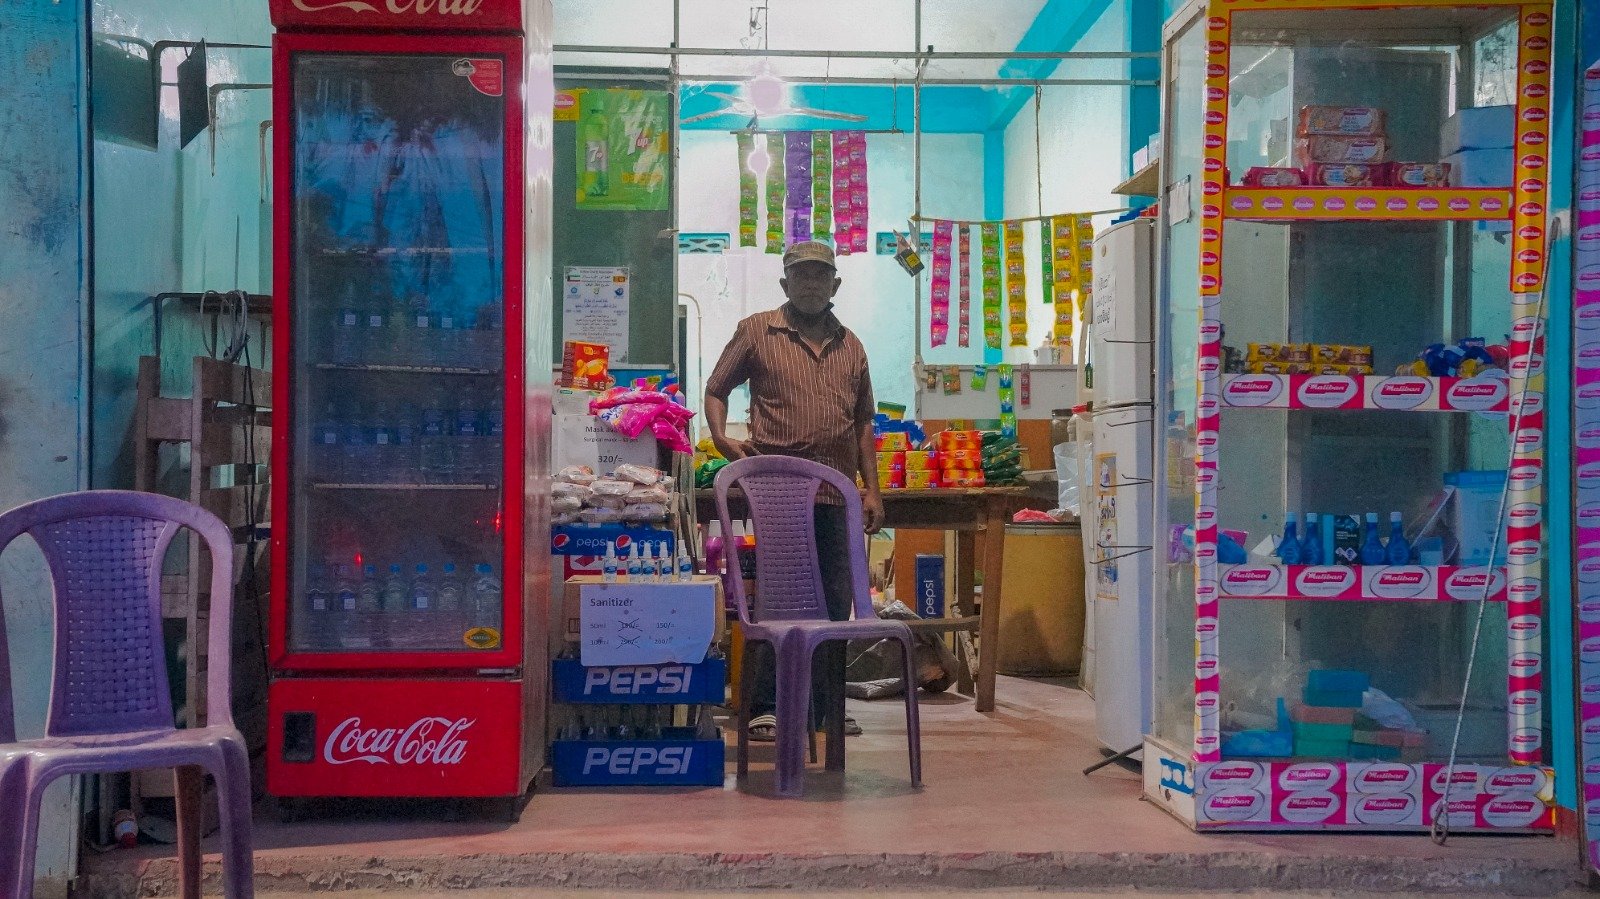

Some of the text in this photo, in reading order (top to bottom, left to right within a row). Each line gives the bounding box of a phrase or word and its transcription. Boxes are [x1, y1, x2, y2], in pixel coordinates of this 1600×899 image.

[1232, 381, 1494, 395] Maliban Maliban Maliban Maliban
[598, 455, 623, 465] 320/=
[1230, 570, 1269, 581] Maliban
[1306, 572, 1345, 582] Maliban
[1381, 573, 1420, 583] Maliban
[590, 597, 634, 607] Sanitizer
[923, 580, 936, 615] pepsi
[583, 666, 693, 695] PEPSI
[582, 746, 694, 775] PEPSI
[1367, 771, 1405, 780] Maliban
[1367, 800, 1405, 809] Maliban
